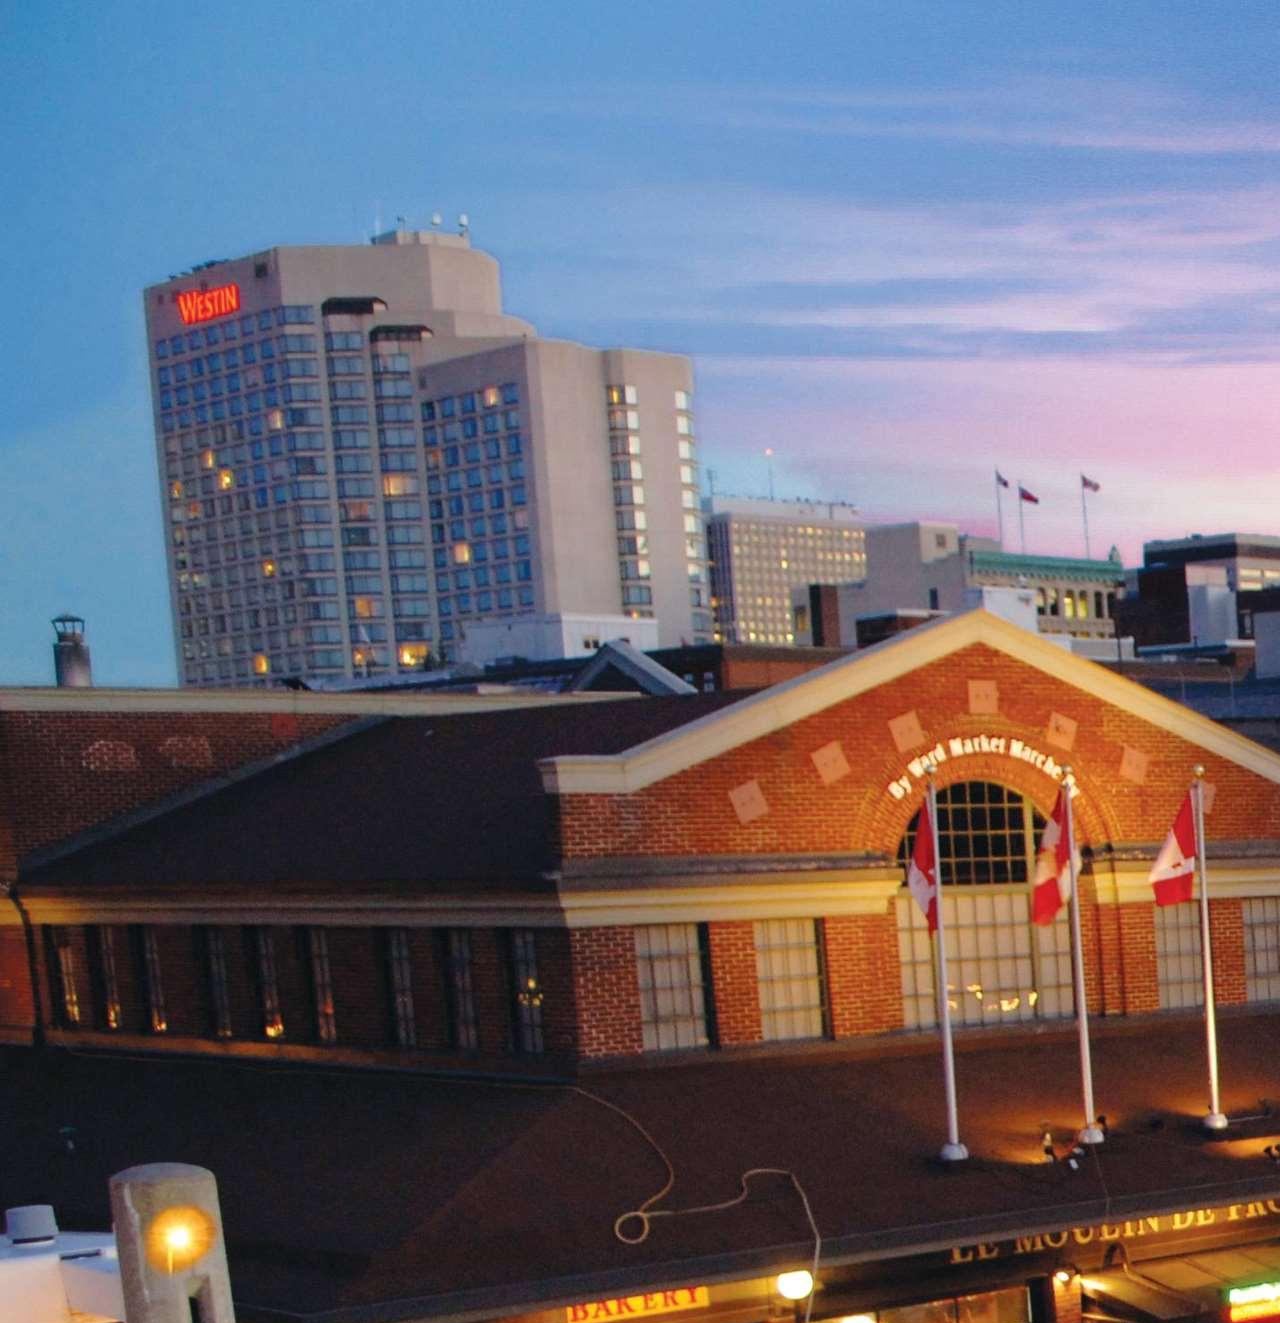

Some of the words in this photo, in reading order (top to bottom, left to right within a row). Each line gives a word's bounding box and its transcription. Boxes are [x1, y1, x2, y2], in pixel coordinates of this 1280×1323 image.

[178, 285, 238, 323] WESTIN
[888, 776, 912, 799] By
[908, 743, 948, 778] Ward
[949, 734, 1006, 757] Market
[570, 1286, 700, 1322] BAKERY
